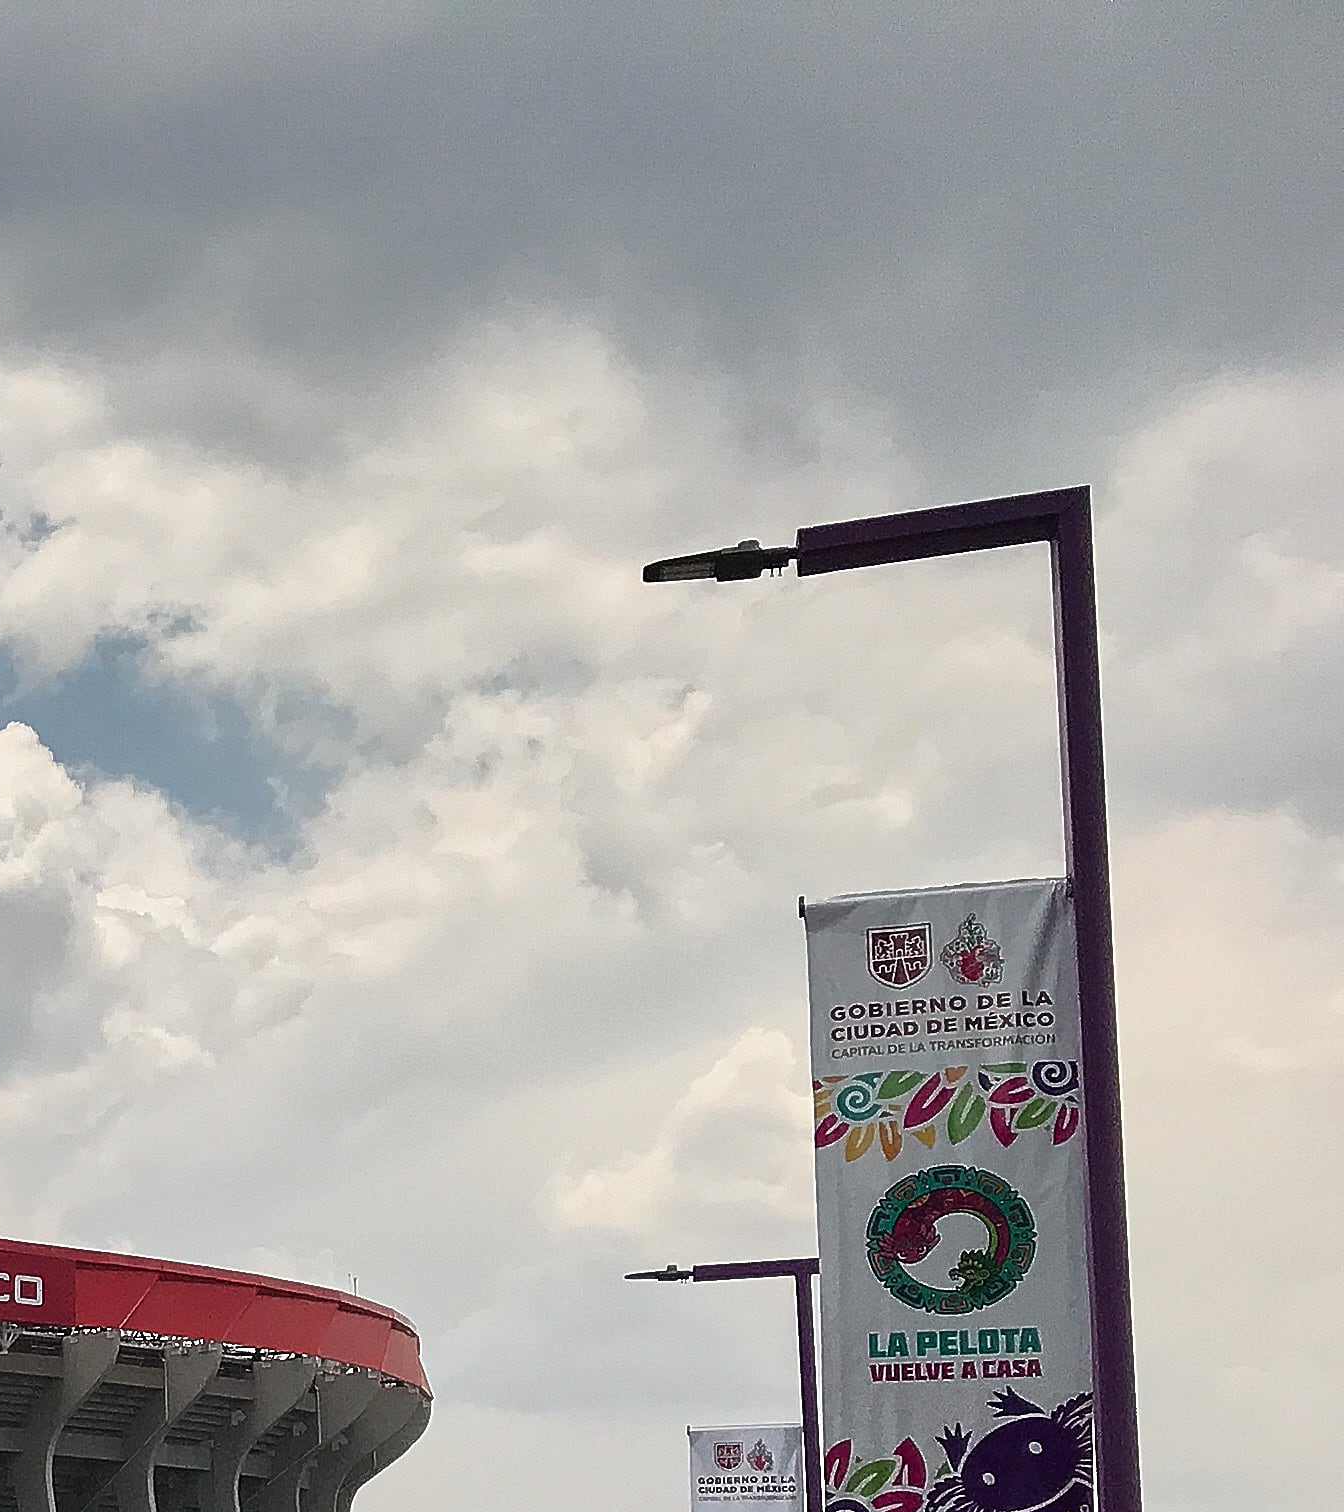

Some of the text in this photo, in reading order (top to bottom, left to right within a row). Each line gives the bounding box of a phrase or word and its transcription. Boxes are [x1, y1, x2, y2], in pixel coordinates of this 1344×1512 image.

[829, 990, 1054, 1021] GOBIERNO DE LA
[830, 1010, 1055, 1042] CIUDAD DE MÉXICO
[831, 1044, 885, 1059] CAPITAL
[888, 1043, 906, 1055] DE
[909, 1041, 926, 1053] LA
[868, 1327, 1043, 1358] LA PELOTA
[869, 1358, 1043, 1382] VUELVE A CASA
[697, 1475, 796, 1485] GOBIERNO DE LA
[698, 1486, 737, 1494] CIUDAD
